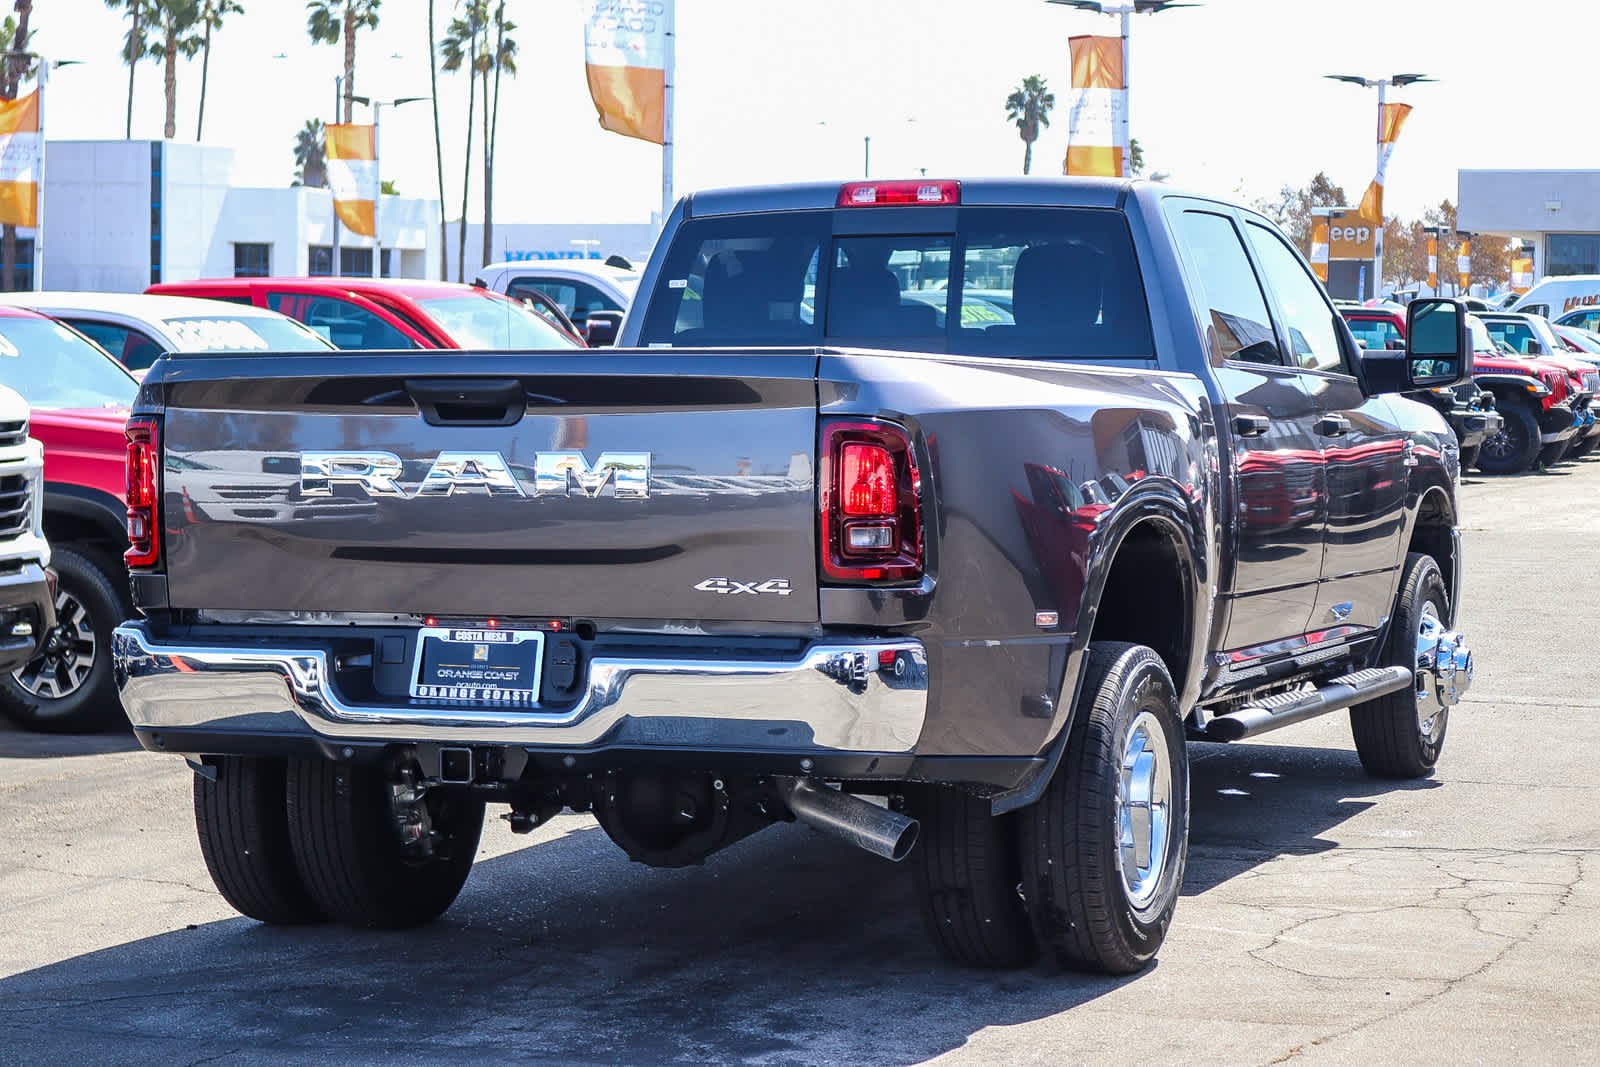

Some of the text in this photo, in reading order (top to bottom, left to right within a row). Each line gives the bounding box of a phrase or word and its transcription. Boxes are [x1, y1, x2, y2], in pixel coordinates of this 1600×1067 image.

[1331, 226, 1370, 244] eep
[300, 450, 651, 498] RAM
[693, 577, 793, 596] 4x4
[455, 631, 507, 642] COSTA MESA
[437, 669, 519, 681] ORANGE COAST
[419, 686, 531, 701] ORANGE COAST
